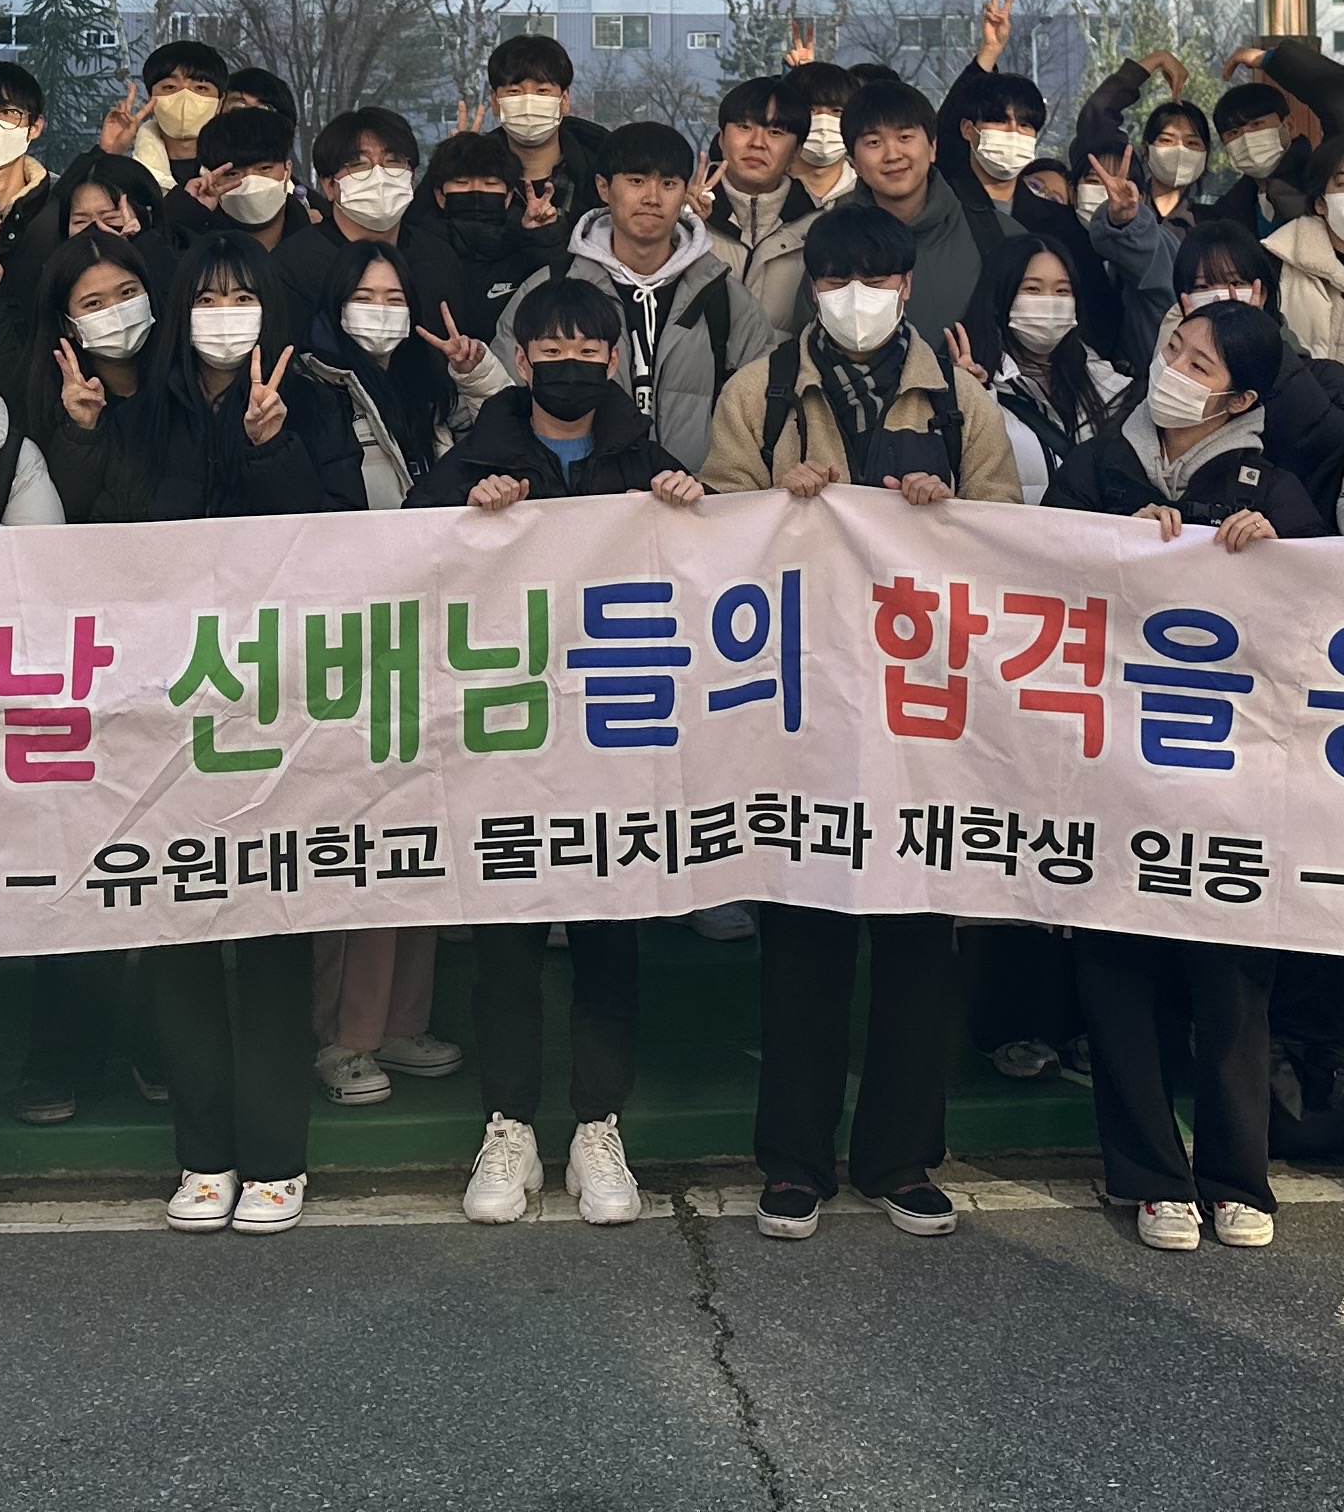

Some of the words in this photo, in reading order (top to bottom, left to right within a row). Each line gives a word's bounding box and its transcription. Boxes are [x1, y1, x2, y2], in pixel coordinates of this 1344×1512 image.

[169, 570, 803, 774] 선배님들의
[873, 576, 1255, 771] 합격을
[86, 824, 446, 908] 유원대학교
[473, 793, 873, 881] 물리치료학과
[896, 804, 1095, 885] 재학생
[1130, 830, 1270, 904] 일동
